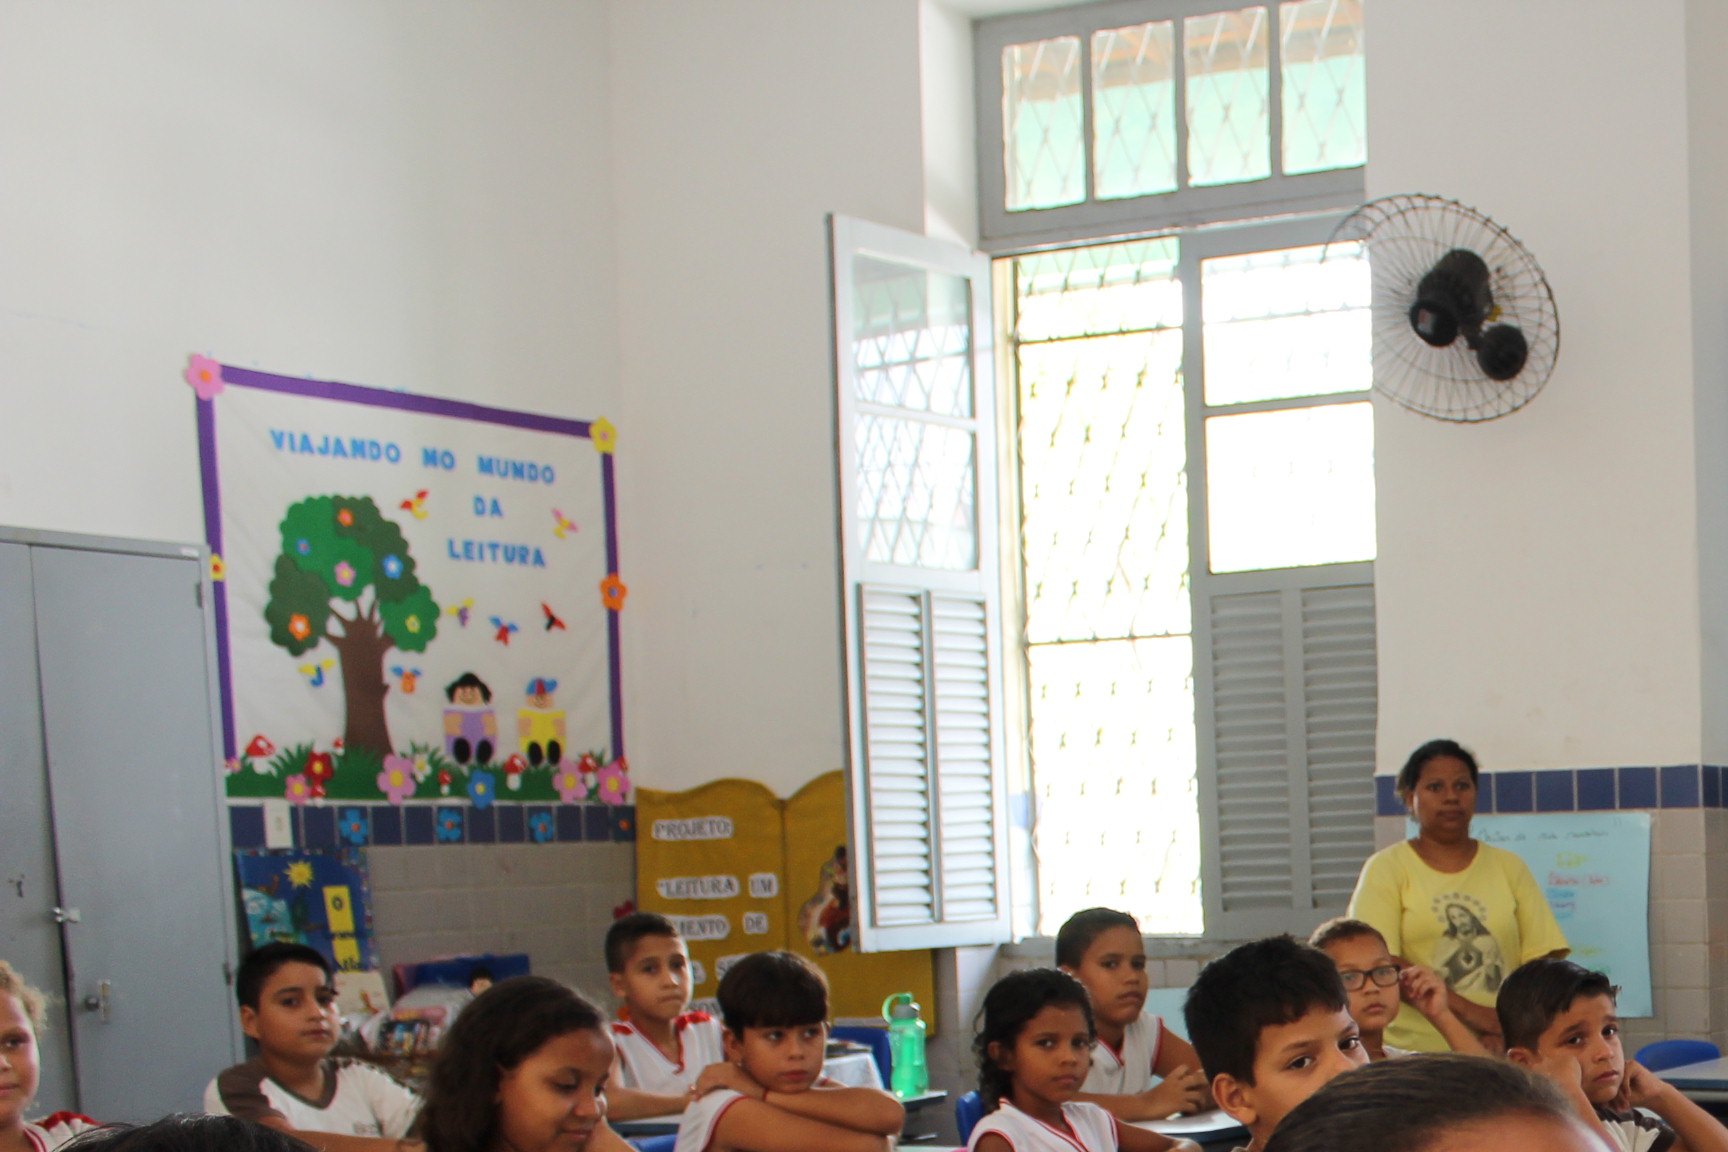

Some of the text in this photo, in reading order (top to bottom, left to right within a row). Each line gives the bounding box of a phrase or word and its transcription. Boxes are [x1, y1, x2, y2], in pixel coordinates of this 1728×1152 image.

[269, 428, 556, 484] VIAJANDO NO MUNDO
[473, 495, 503, 519] DA
[447, 538, 546, 567] LEITURA
[750, 878, 772, 893] UM
[745, 915, 764, 931] DE
